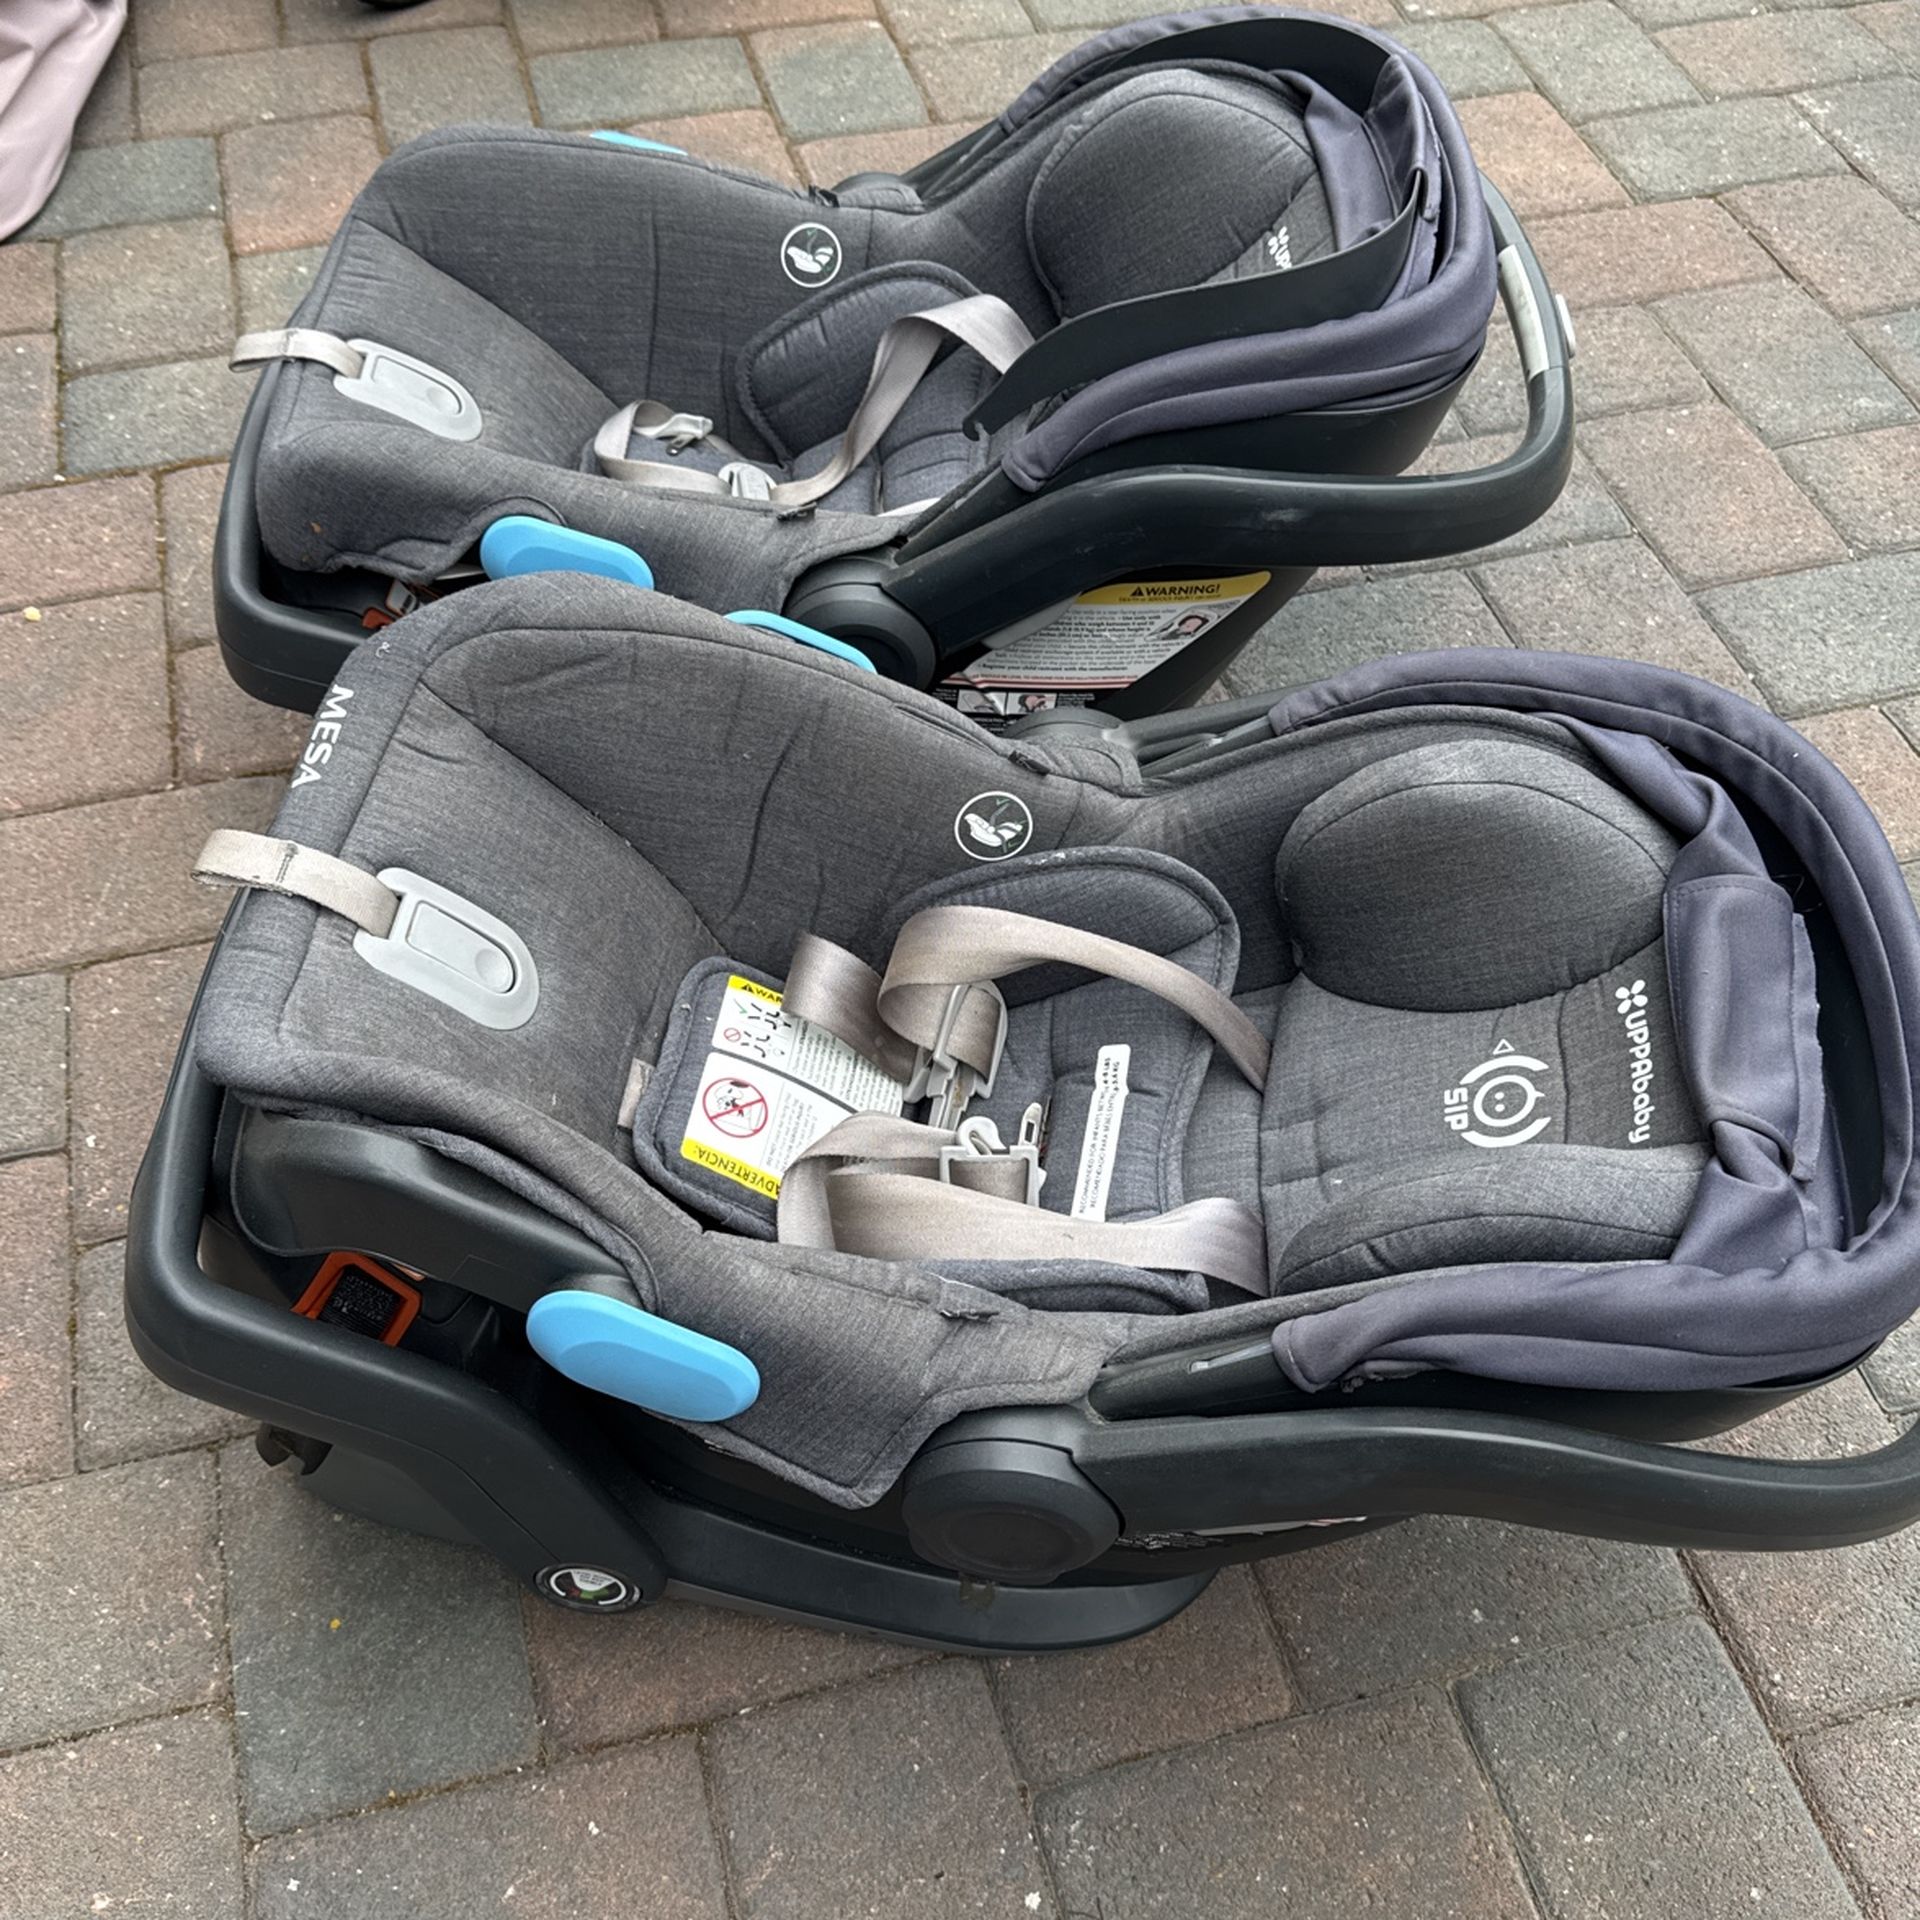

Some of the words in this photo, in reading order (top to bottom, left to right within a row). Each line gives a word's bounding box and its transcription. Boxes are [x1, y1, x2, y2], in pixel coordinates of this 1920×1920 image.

[1145, 584, 1221, 596] WARNING!
[290, 683, 354, 789] MESA
[1444, 1087, 1468, 1130] SIP
